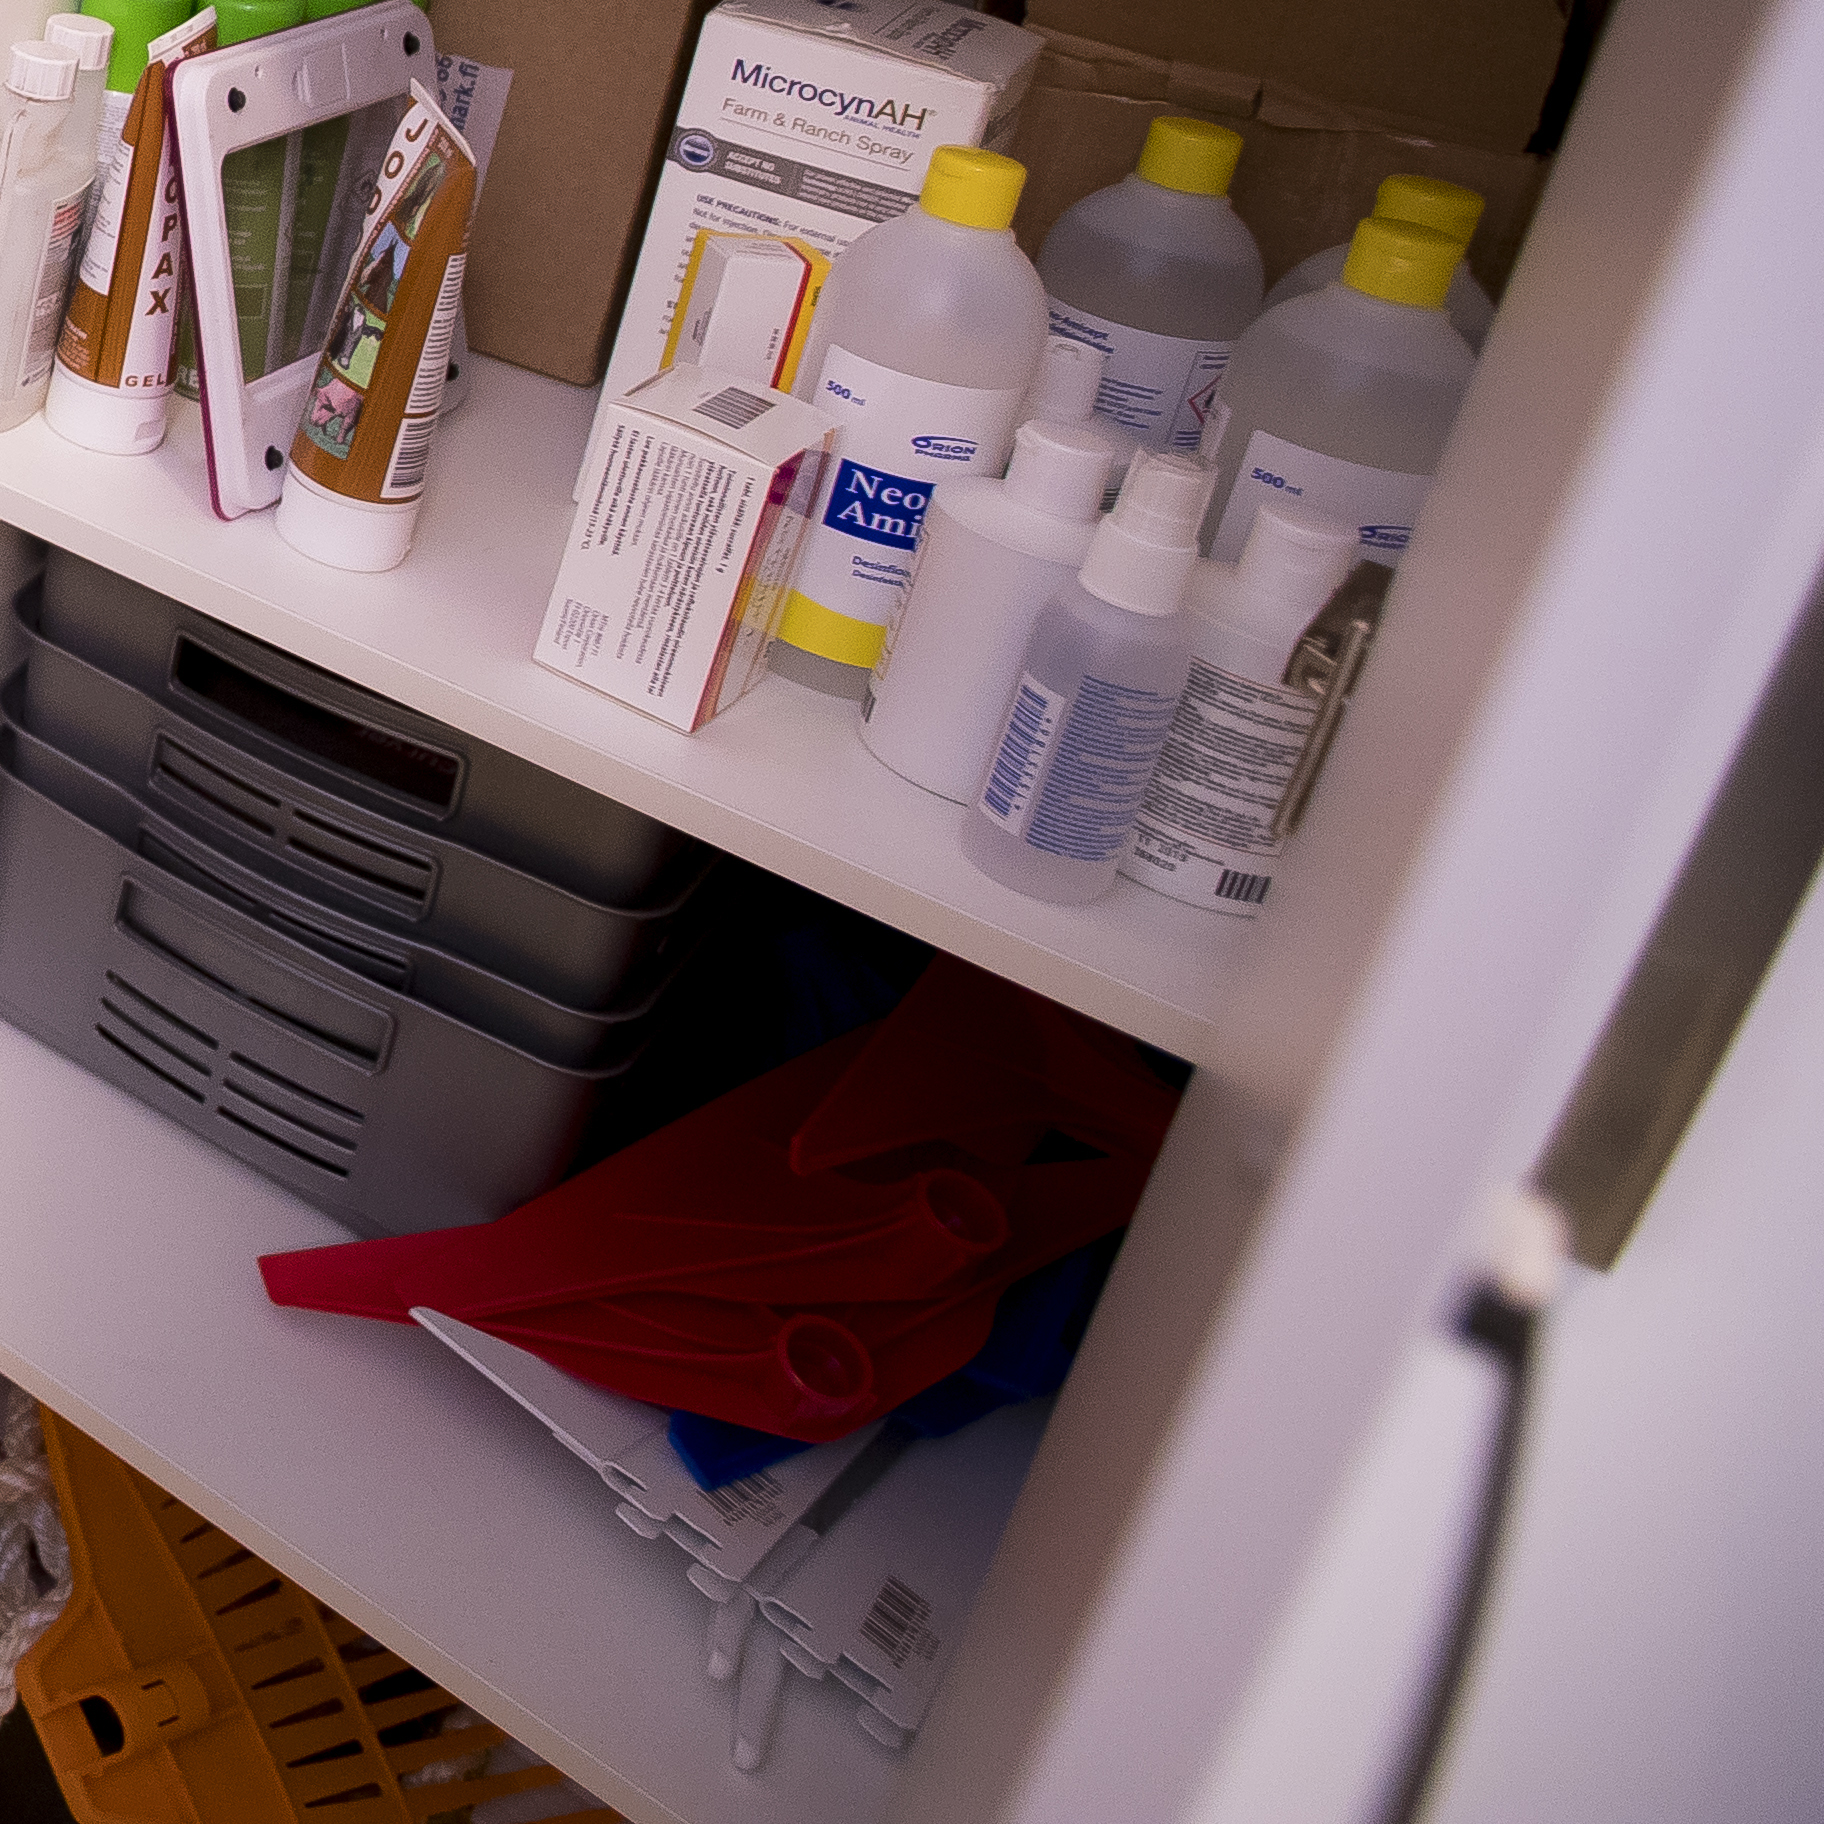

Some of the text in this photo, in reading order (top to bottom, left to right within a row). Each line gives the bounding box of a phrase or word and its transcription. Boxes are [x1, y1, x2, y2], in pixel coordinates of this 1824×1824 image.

[730, 58, 928, 132] MicrocynAH
[721, 96, 915, 166] Farm & Ranch Spray
[696, 193, 715, 206] USE
[715, 198, 783, 227] PRECAUTIONS:
[783, 219, 799, 233] For
[124, 371, 167, 390] GEL
[825, 379, 867, 407] 500 ml
[910, 434, 979, 456] ORION
[914, 447, 971, 463] PHARMA
[844, 467, 928, 511] Neo
[1251, 466, 1285, 489] 500
[836, 499, 924, 539] Ami
